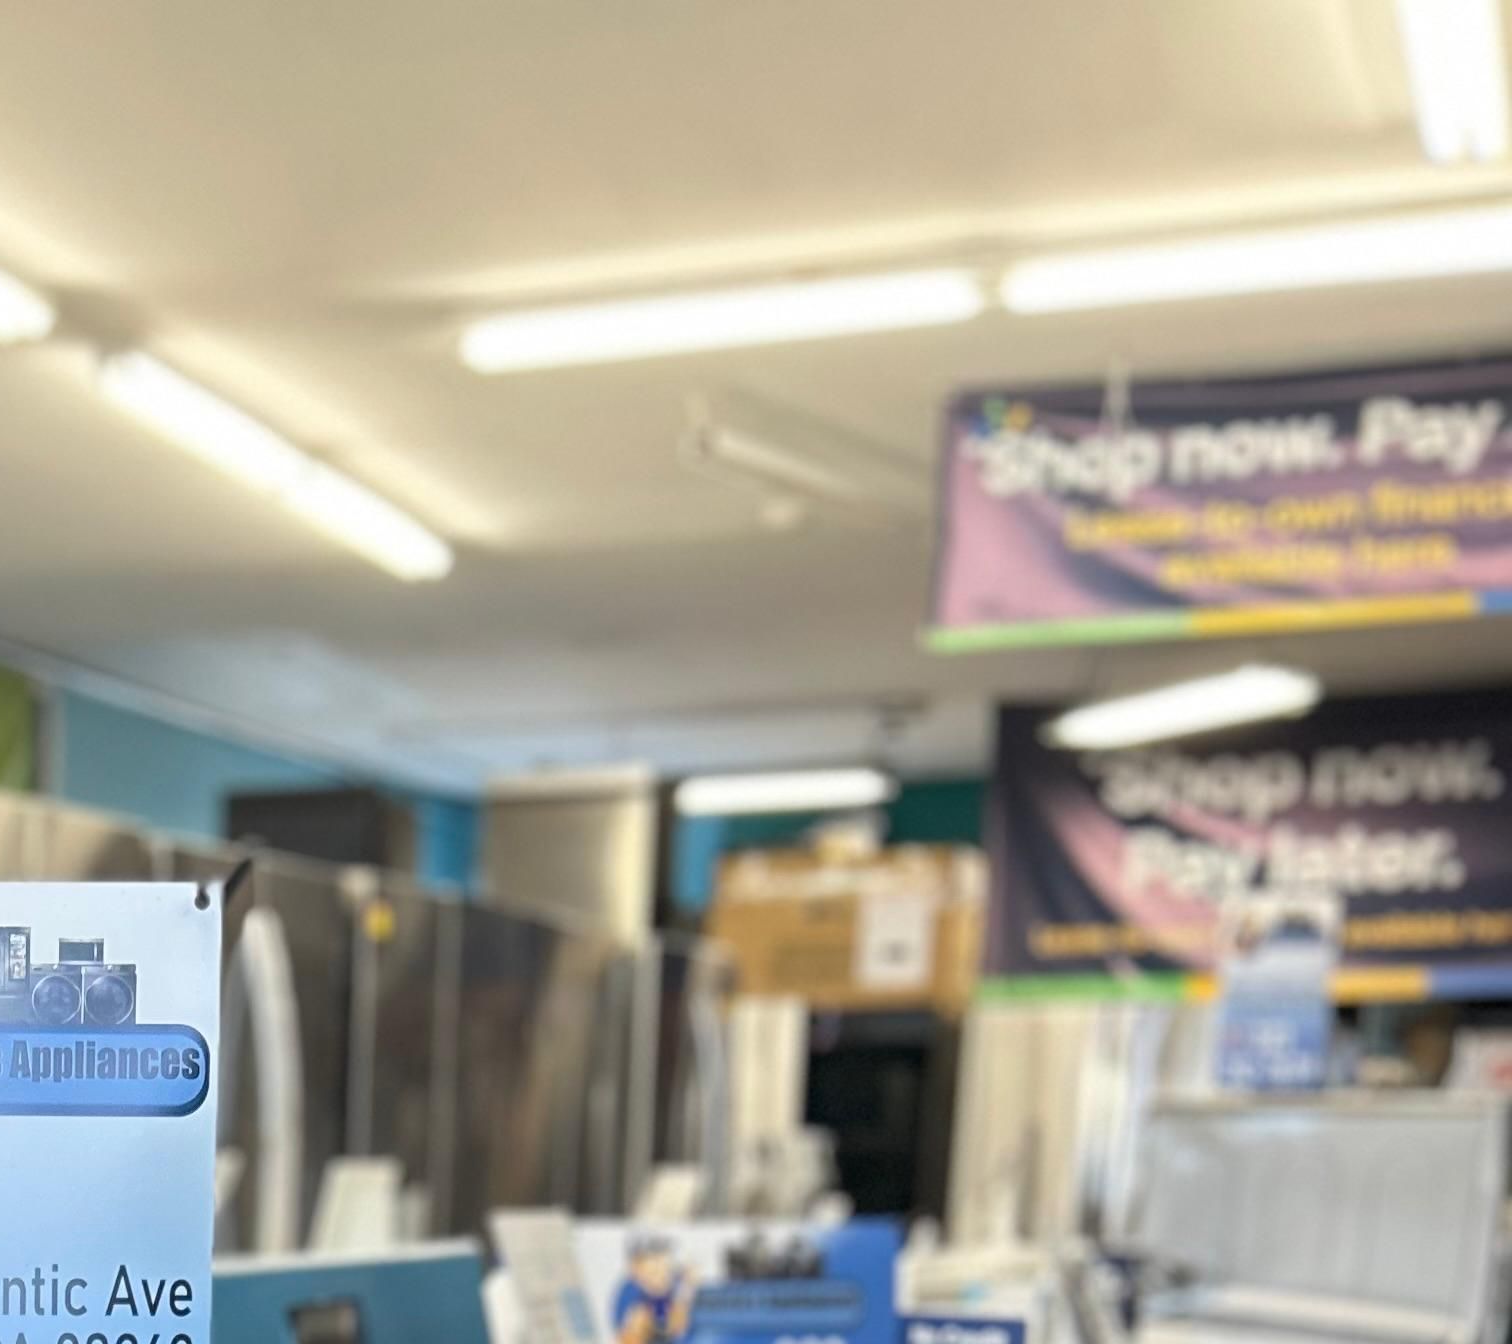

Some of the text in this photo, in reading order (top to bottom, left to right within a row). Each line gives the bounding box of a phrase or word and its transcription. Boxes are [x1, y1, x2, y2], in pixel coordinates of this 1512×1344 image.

[985, 428, 1163, 497] Shop
[1359, 397, 1499, 472] Pay
[9, 1039, 200, 1083] Appliances
[105, 1265, 193, 1317] Ave
